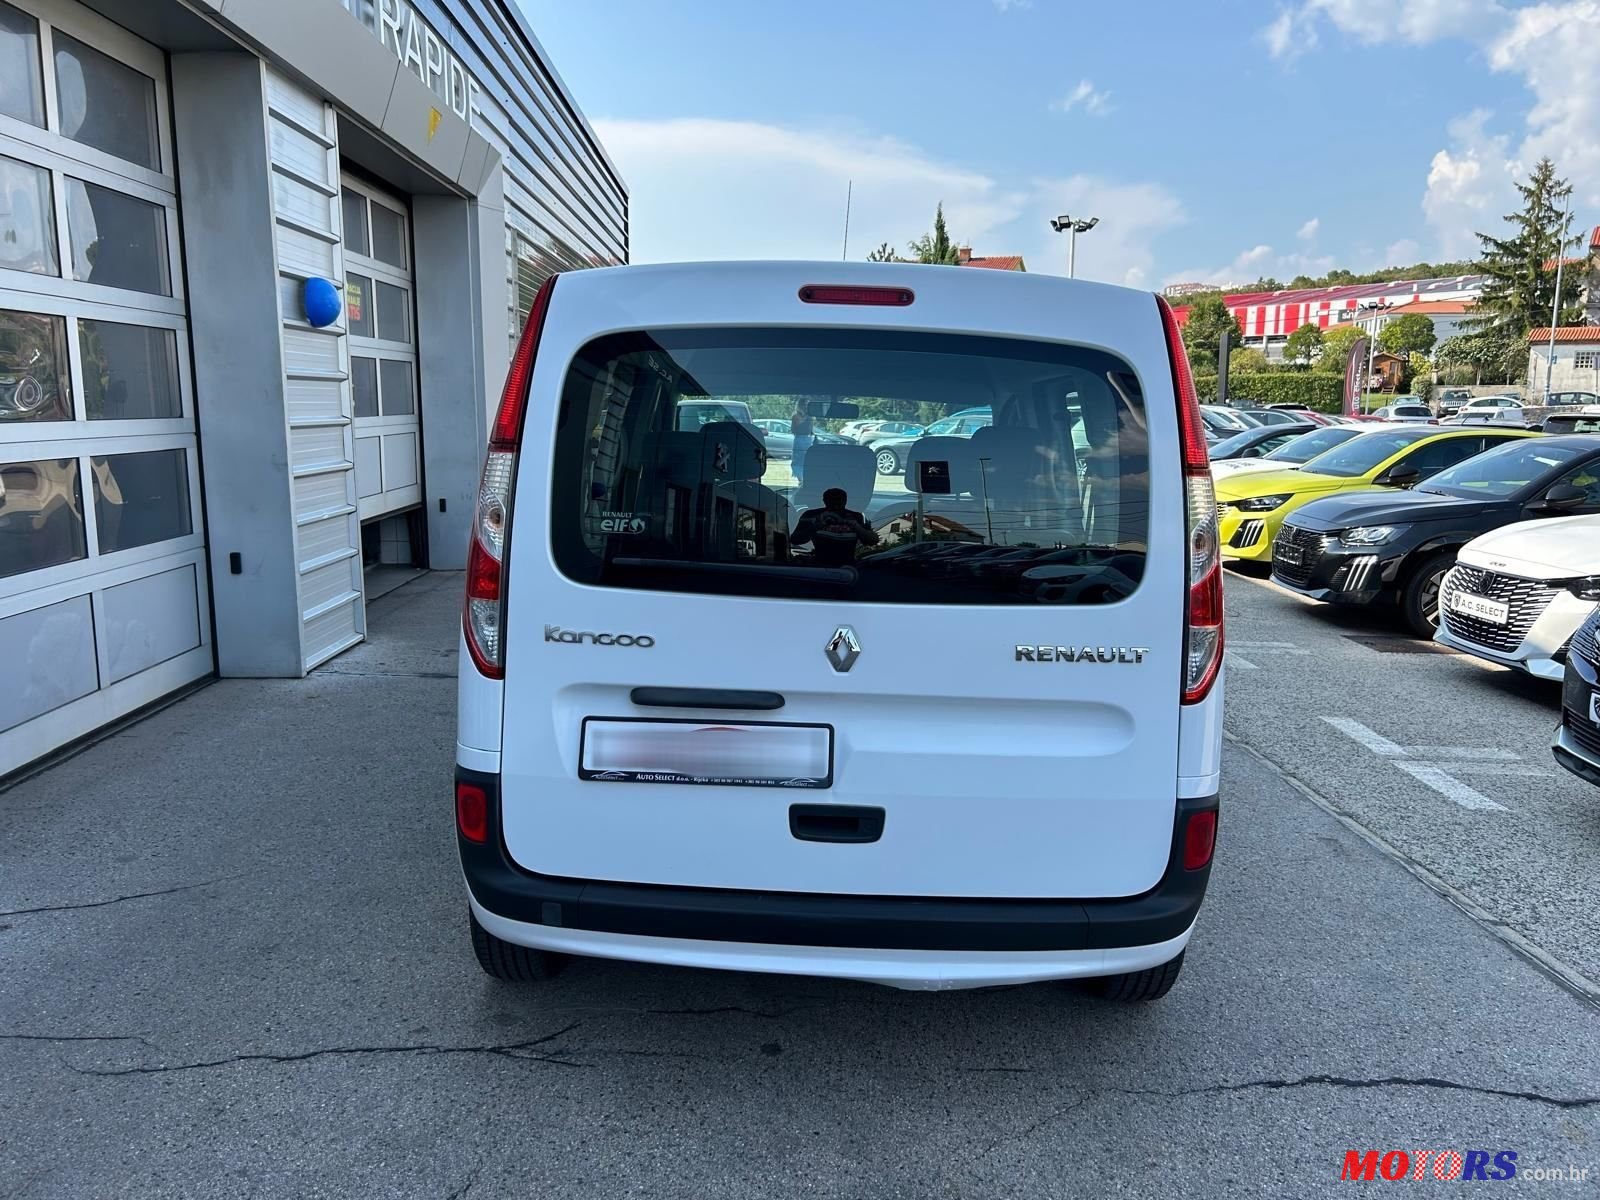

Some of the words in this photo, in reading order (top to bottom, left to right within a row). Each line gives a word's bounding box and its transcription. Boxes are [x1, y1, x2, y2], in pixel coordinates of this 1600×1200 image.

[600, 518, 629, 532] elf
[1475, 603, 1505, 618] SELECT
[544, 623, 655, 648] Kangoo
[1015, 644, 1150, 664] RENAULT
[655, 774, 675, 782] SELECT
